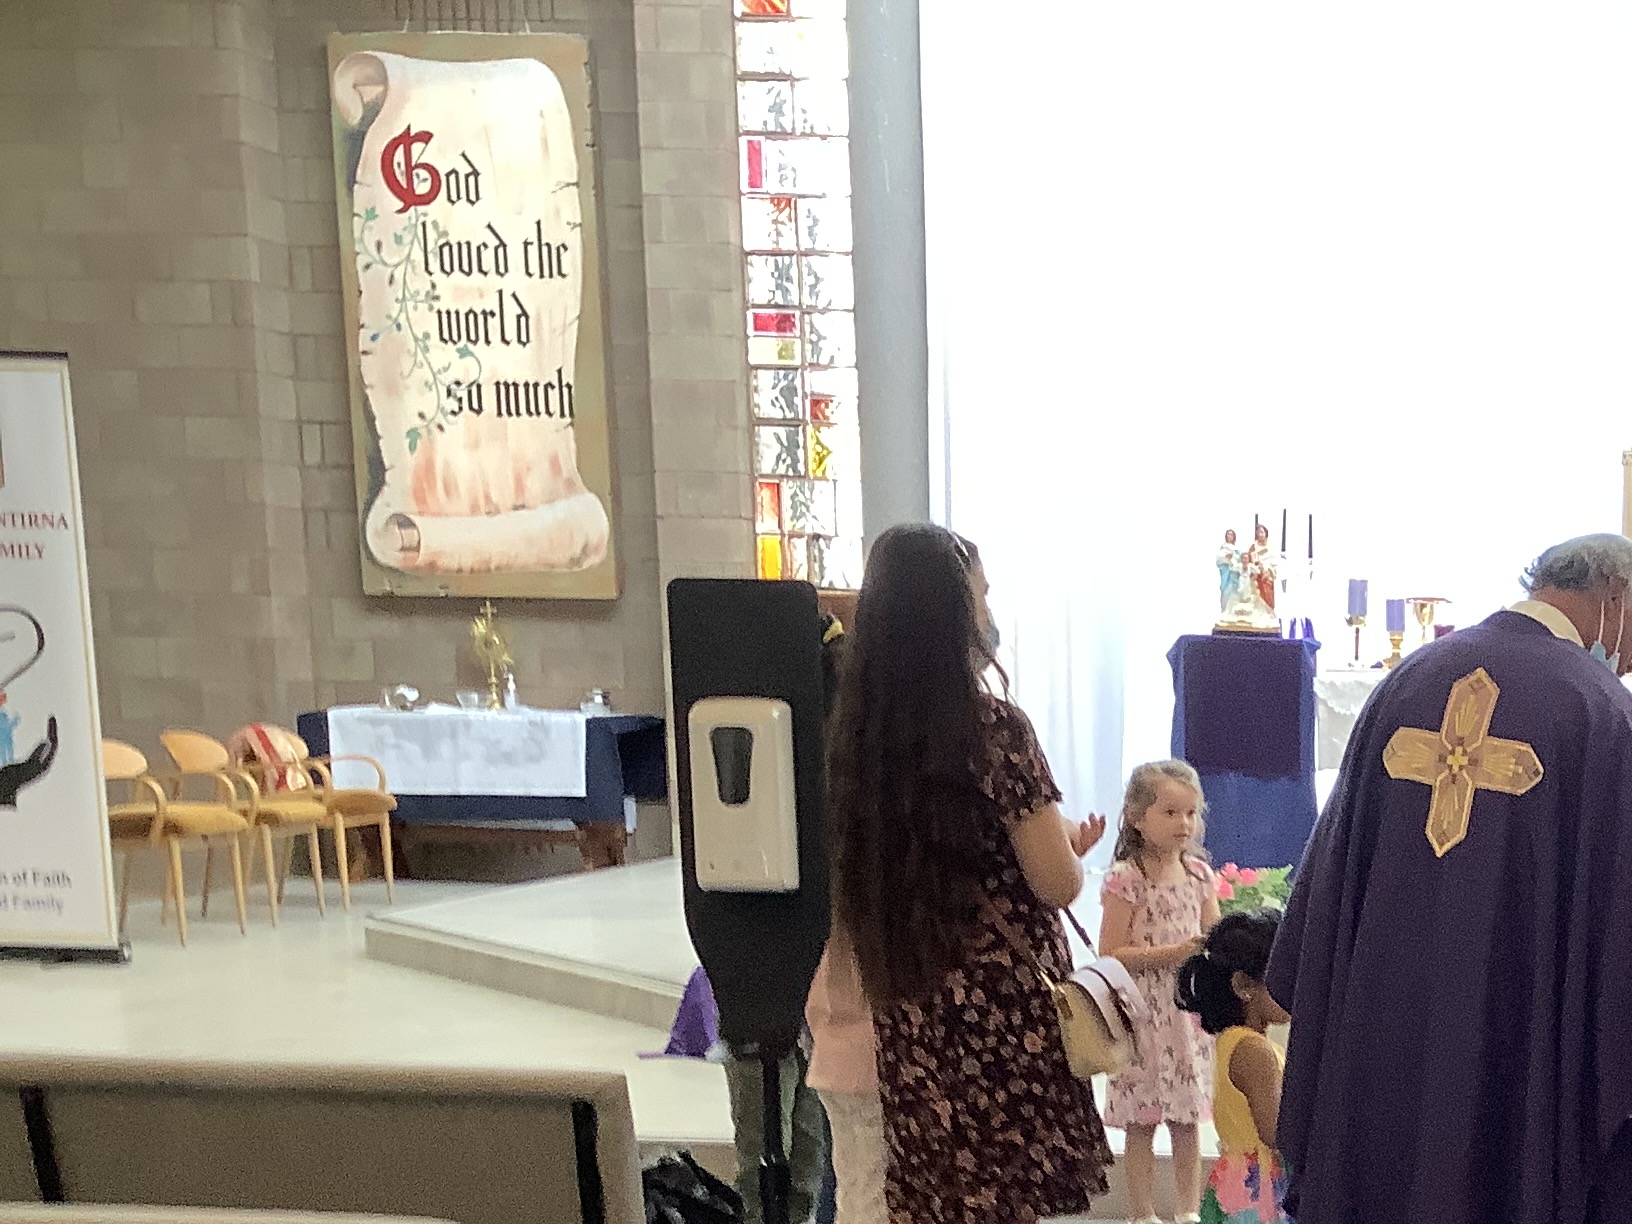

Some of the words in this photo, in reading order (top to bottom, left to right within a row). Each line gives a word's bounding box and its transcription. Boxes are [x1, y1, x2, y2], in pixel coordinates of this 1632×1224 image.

[380, 123, 481, 214] God
[421, 220, 510, 279] loved
[522, 218, 569, 280] the
[436, 288, 531, 348] world
[446, 379, 484, 417] so
[494, 366, 575, 419] much
